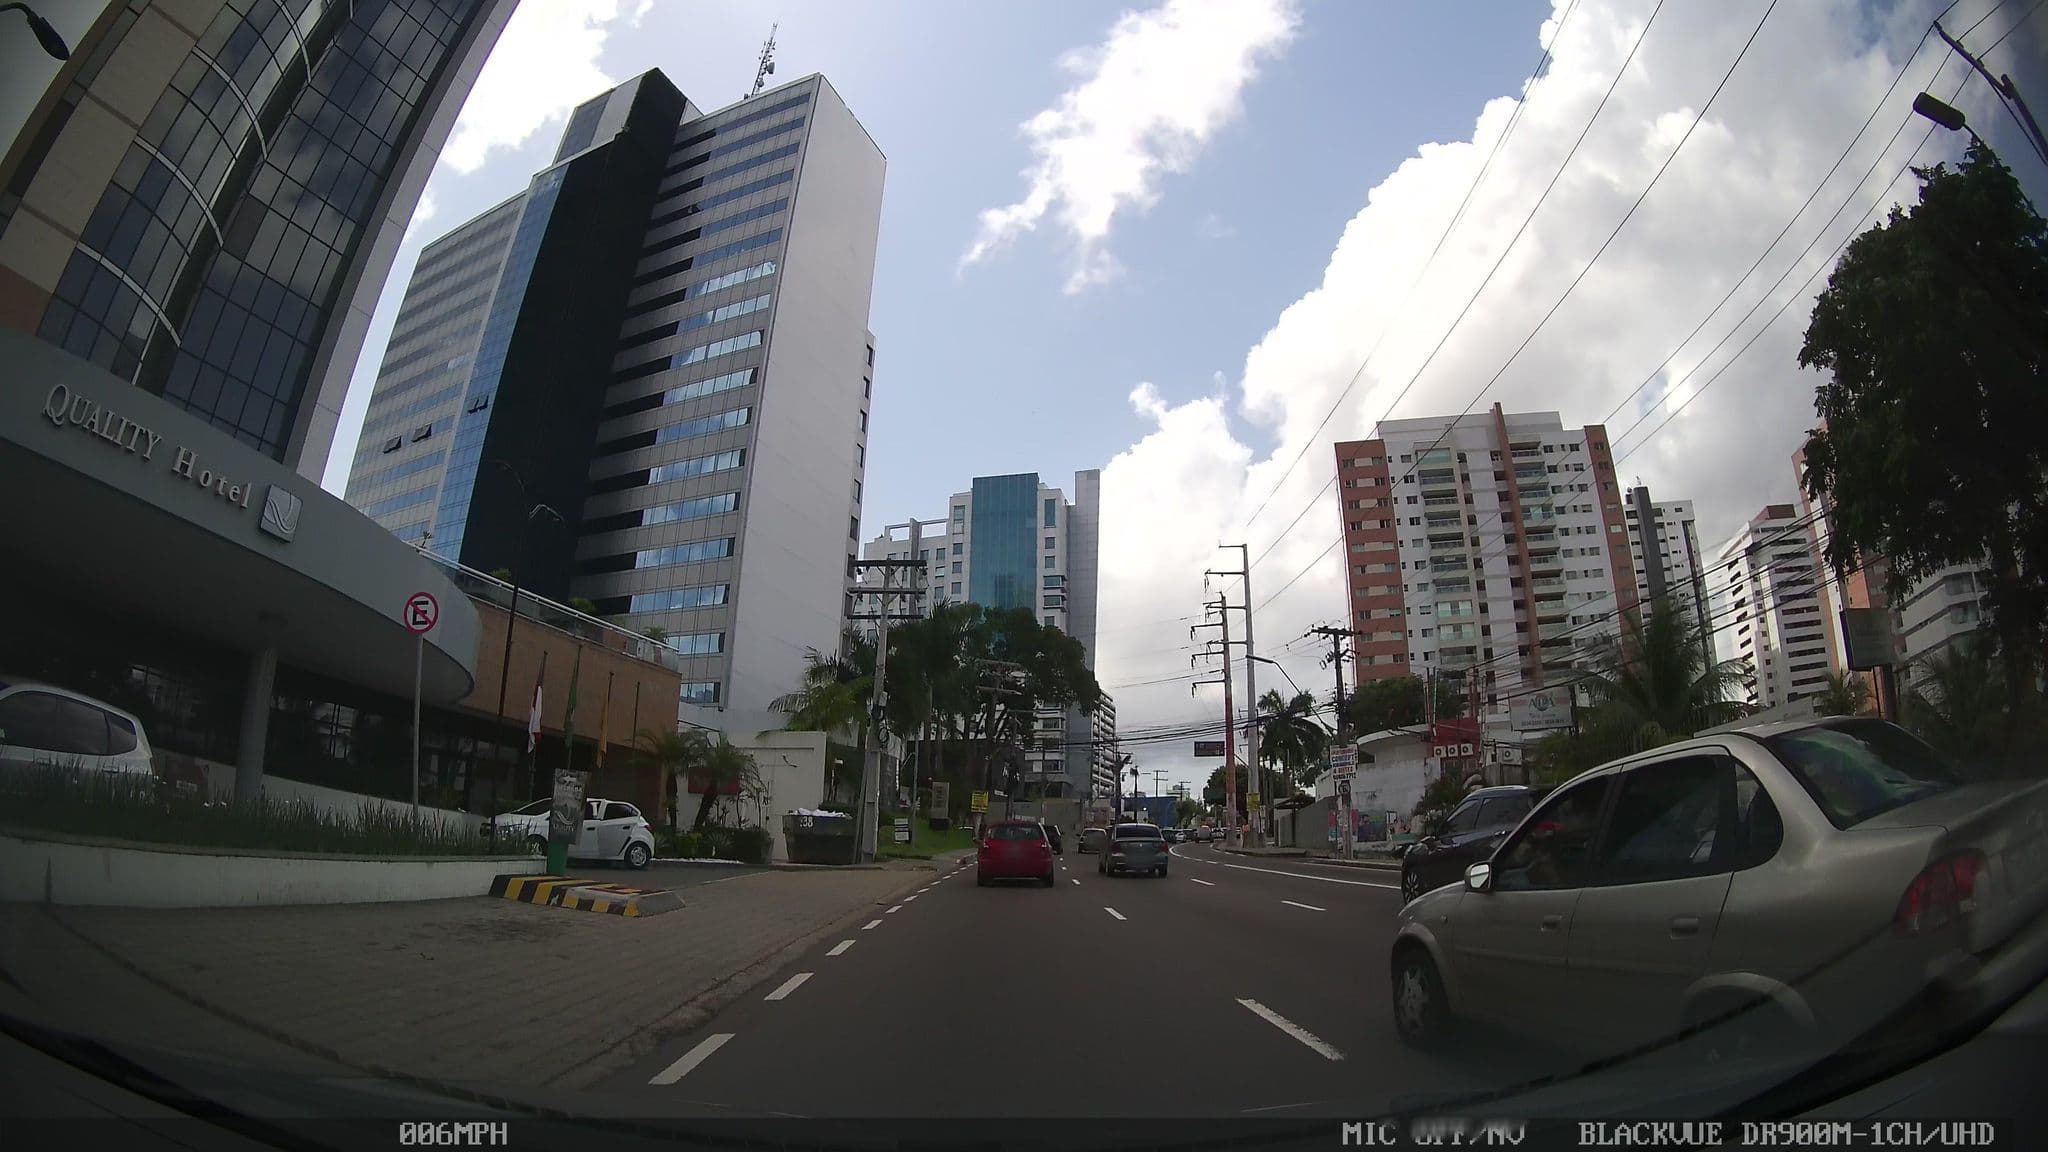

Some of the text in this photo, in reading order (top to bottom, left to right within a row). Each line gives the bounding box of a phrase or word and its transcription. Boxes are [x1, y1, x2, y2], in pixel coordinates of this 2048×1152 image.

[43, 383, 251, 508] QUALITY Hotel
[412, 600, 430, 625] E
